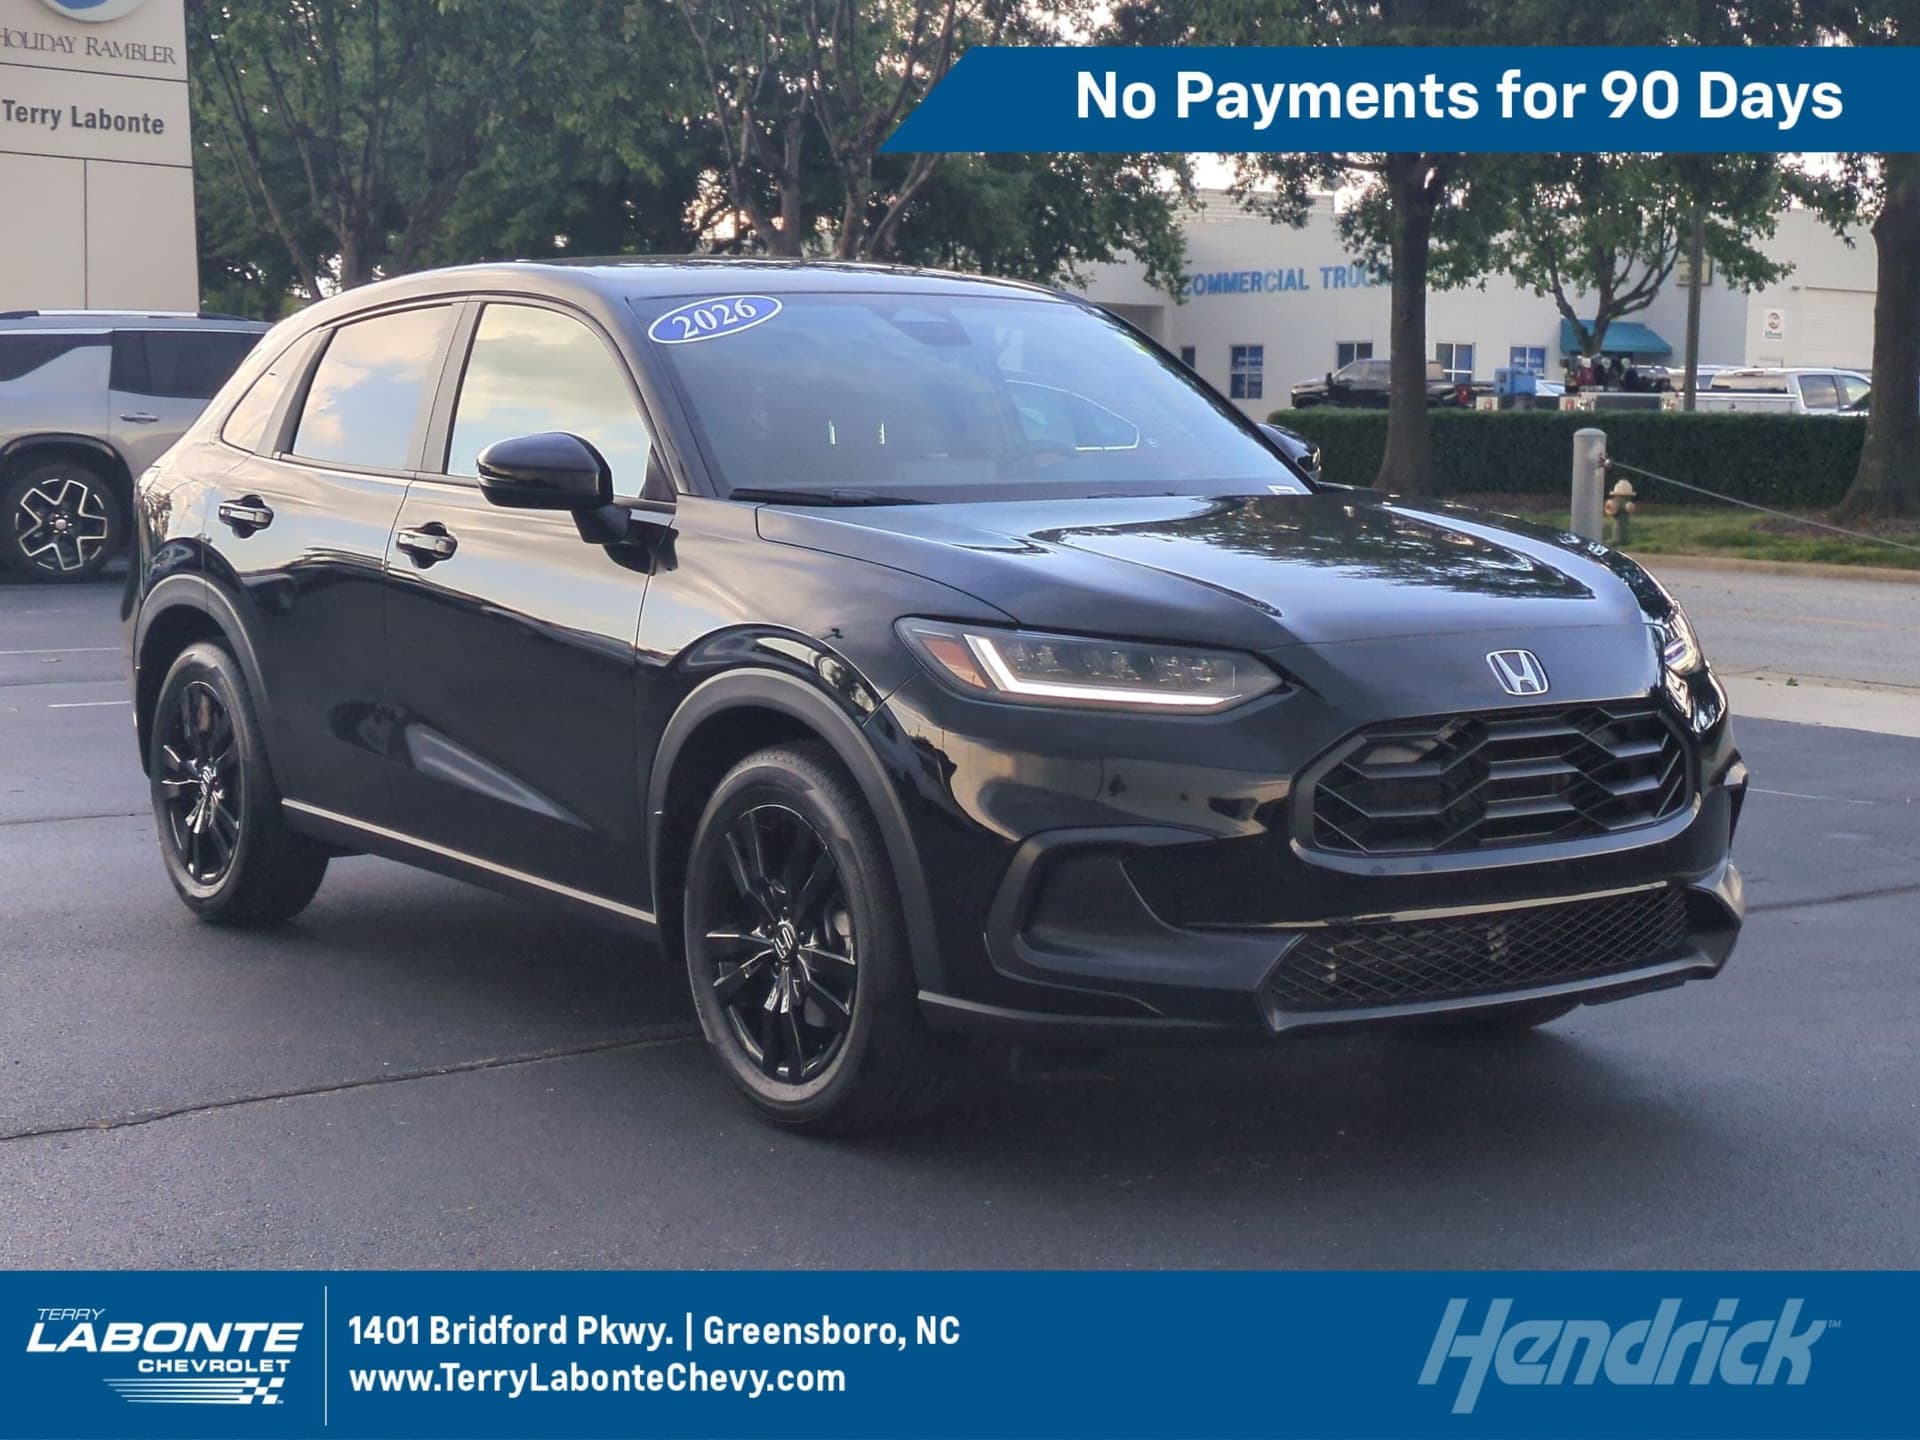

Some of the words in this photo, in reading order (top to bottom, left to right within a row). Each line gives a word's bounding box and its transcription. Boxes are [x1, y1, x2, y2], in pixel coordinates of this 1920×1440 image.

[86, 36, 176, 64] RAMBLER
[3, 99, 62, 130] Terry
[71, 105, 164, 135] Labonte
[1319, 263, 1392, 289] TRUC
[671, 297, 757, 339] 2026
